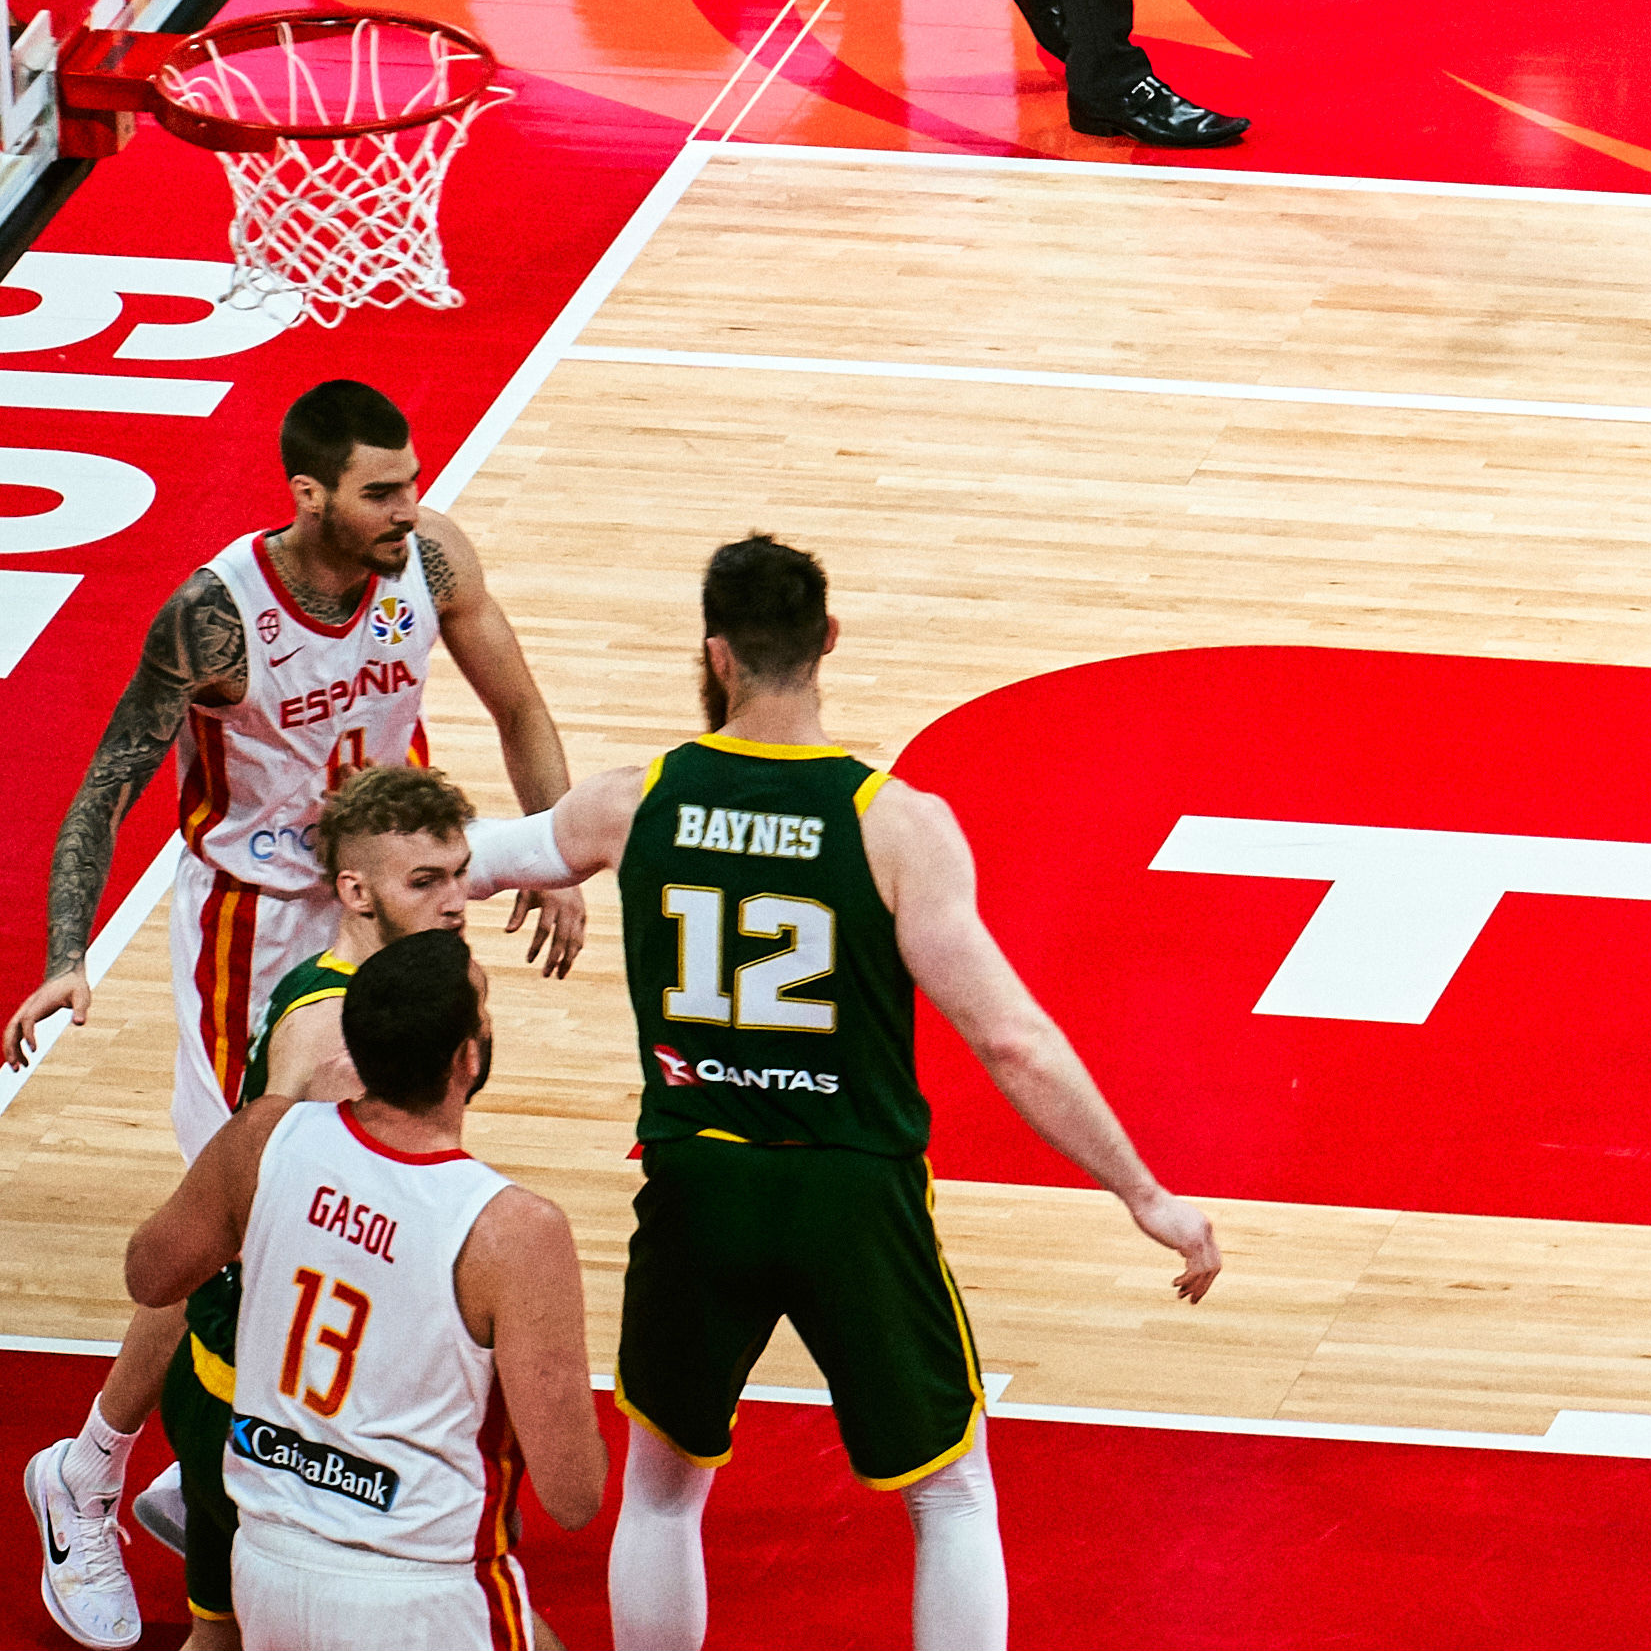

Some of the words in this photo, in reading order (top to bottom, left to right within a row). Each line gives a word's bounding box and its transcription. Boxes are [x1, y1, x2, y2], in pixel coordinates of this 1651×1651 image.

[279, 658, 418, 730] ESPAÑA
[673, 803, 826, 861] BAYNES
[662, 883, 838, 1035] 12
[696, 1058, 840, 1095] QANTAS
[307, 1185, 400, 1265] GASOL
[278, 1265, 374, 1420] 13
[251, 1424, 388, 1508] CaixaBank
